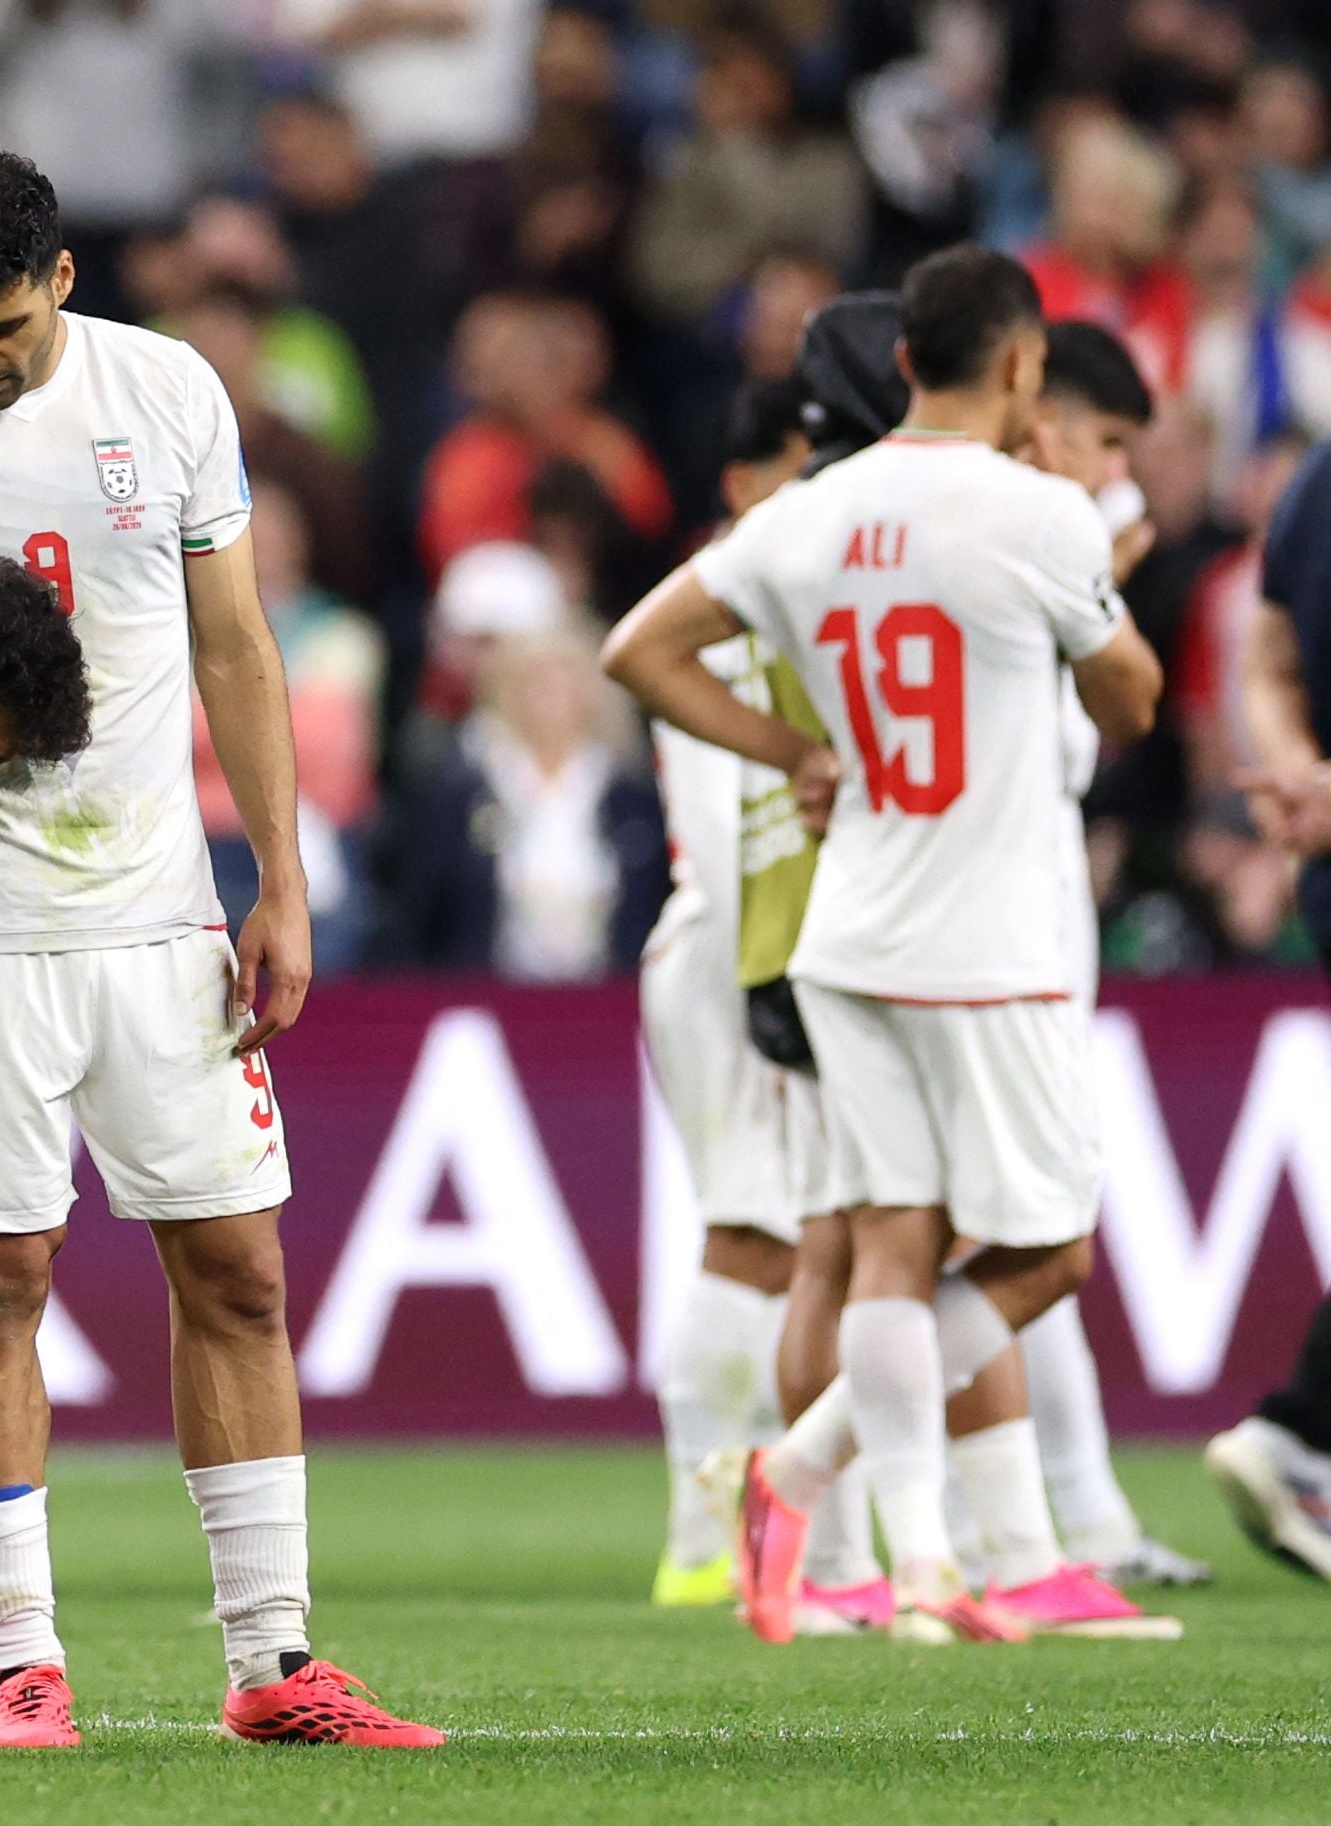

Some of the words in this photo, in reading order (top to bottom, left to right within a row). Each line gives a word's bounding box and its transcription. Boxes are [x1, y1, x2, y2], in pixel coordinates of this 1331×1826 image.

[842, 522, 908, 571] ALI
[815, 603, 967, 818] 19
[240, 1048, 274, 1130] 9
